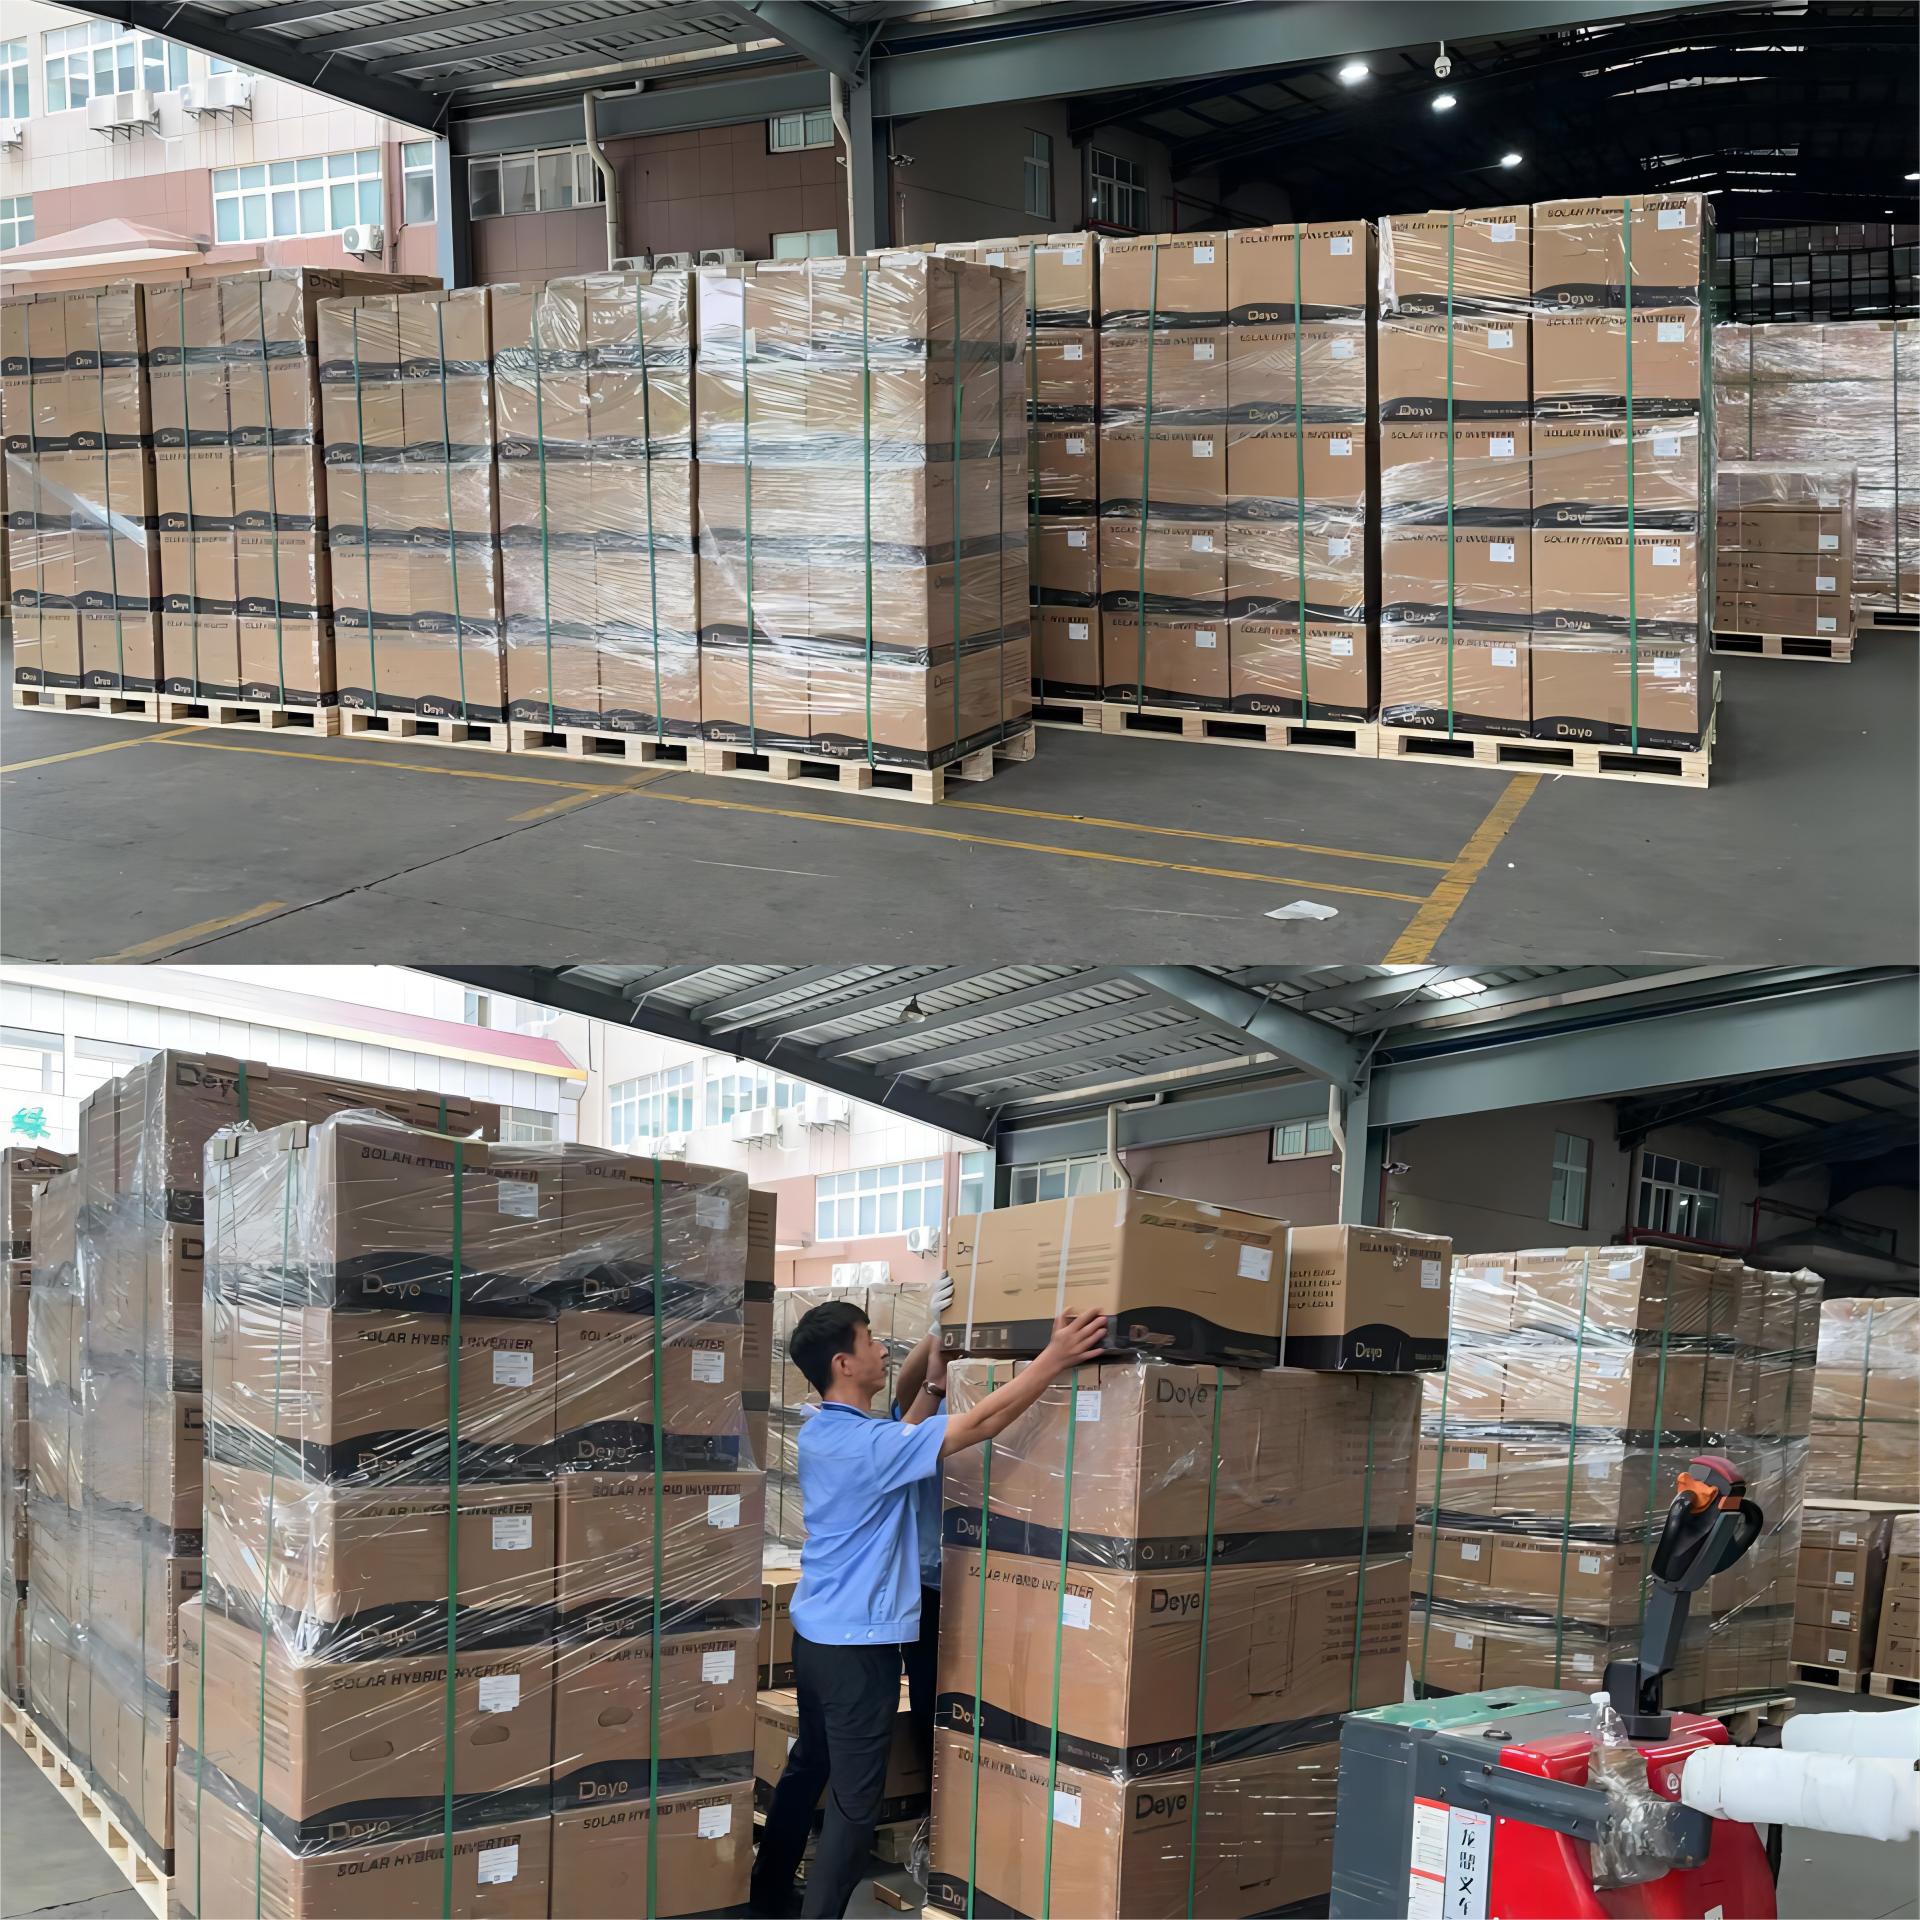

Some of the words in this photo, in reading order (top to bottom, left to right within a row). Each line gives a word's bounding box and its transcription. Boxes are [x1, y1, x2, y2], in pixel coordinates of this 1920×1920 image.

[333, 1673, 386, 1691] SOLAR
[583, 1812, 626, 1830] SOLAR
[337, 1856, 390, 1878] SOLAR
